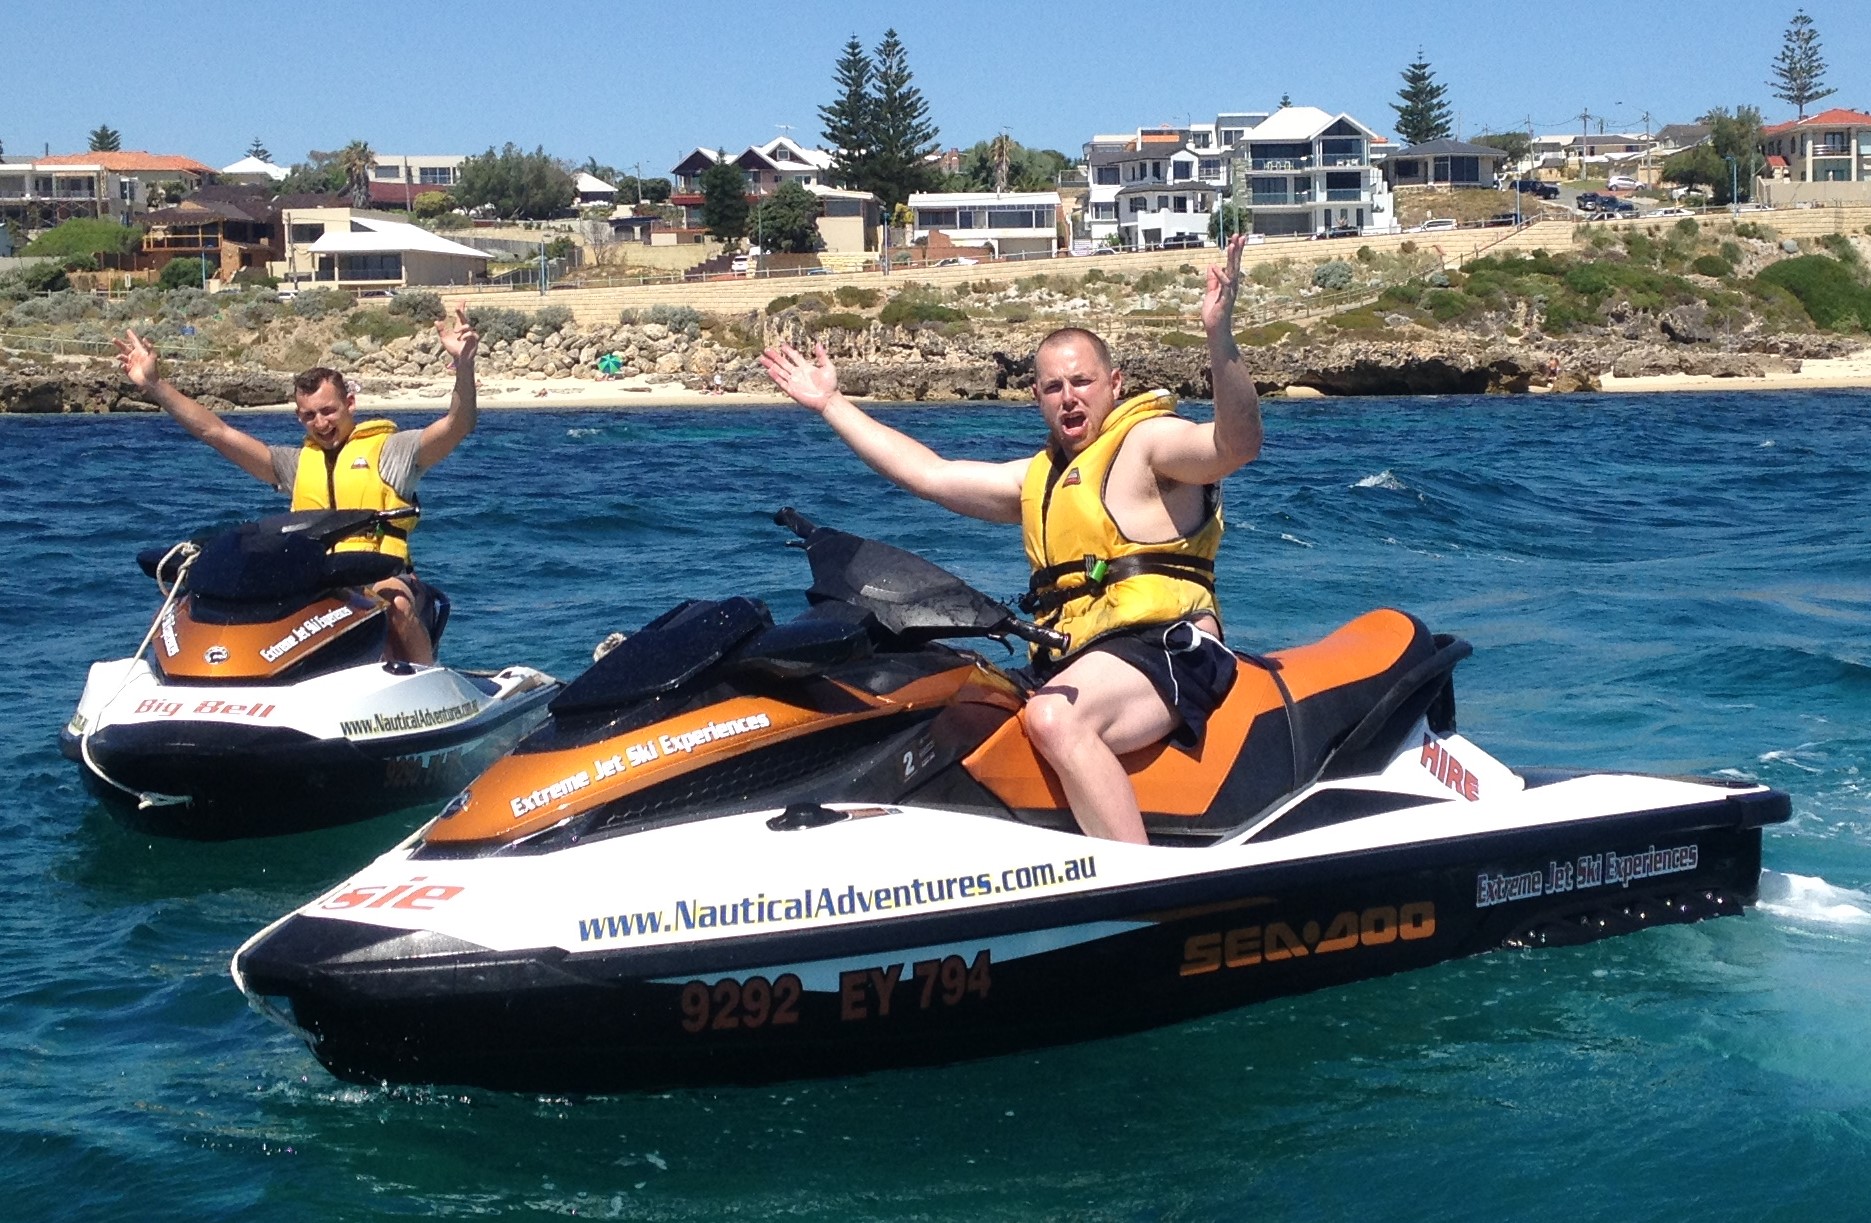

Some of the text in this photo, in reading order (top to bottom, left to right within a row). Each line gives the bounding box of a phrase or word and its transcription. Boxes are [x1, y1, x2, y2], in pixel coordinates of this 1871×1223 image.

[134, 698, 276, 718] Big Bell
[509, 770, 591, 818] Extreme
[593, 754, 626, 782] Jet
[625, 739, 659, 768] Ski
[657, 712, 772, 756] Experiences
[902, 750, 915, 777] 2
[1420, 731, 1480, 802] HIRE
[317, 875, 466, 911] sie
[578, 855, 1098, 942] www.NauticalAdventures.com.au
[1475, 845, 1698, 908] Extreme Jet Ski Experiences
[681, 949, 992, 1033] 9292 EY 794
